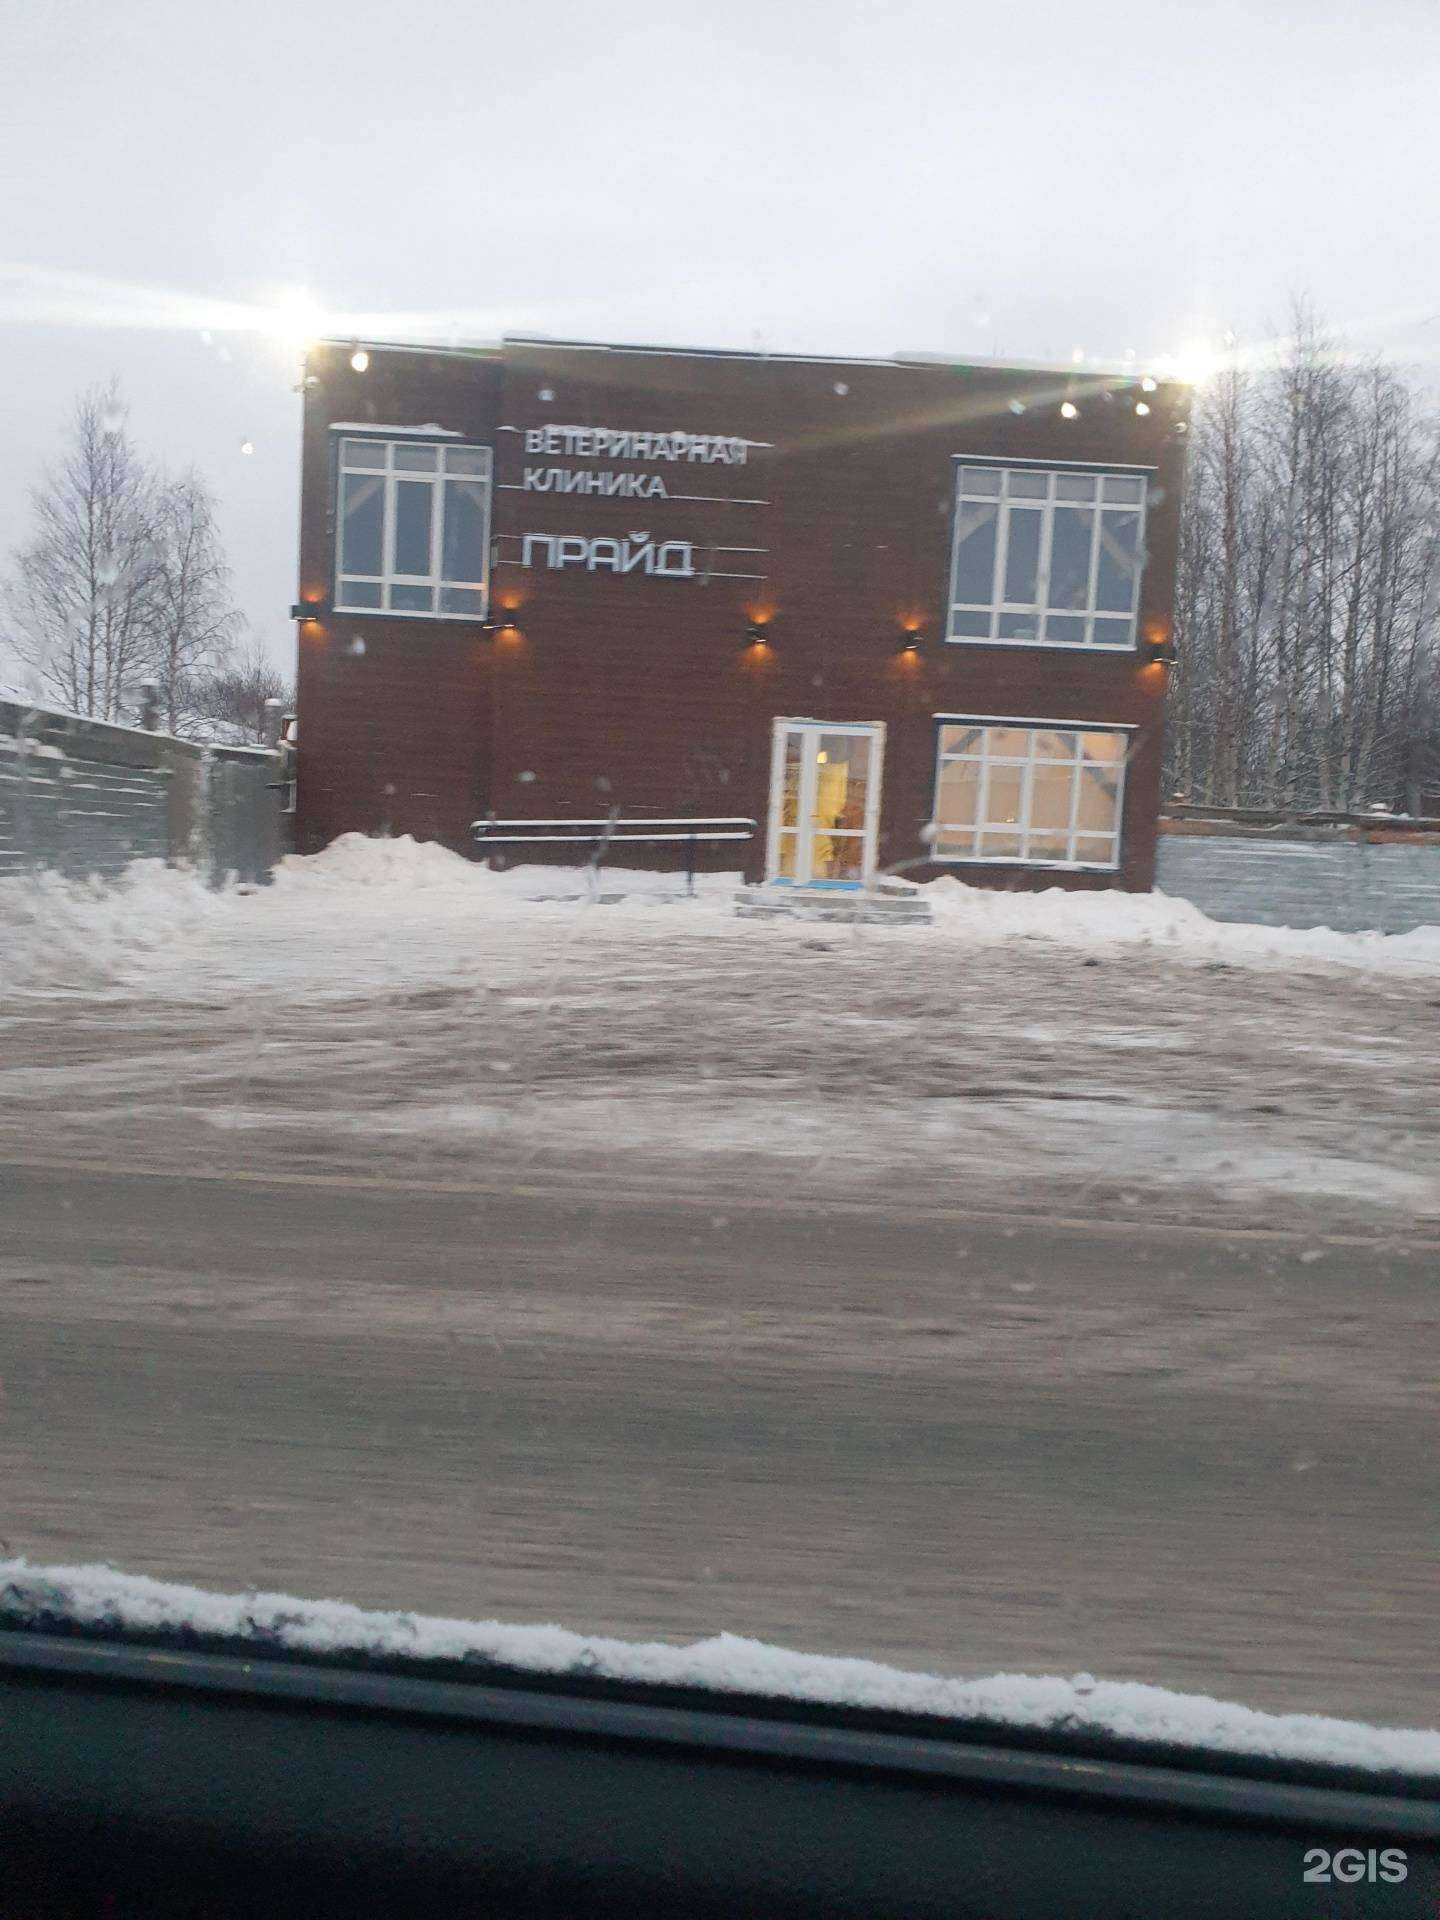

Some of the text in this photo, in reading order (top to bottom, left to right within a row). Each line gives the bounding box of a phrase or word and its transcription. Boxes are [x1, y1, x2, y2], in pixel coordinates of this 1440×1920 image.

[525, 426, 748, 465] ВЕТЕРИНАРНАЯ
[523, 467, 670, 500] КЛИНИКА
[521, 530, 696, 577] ПРАЙД
